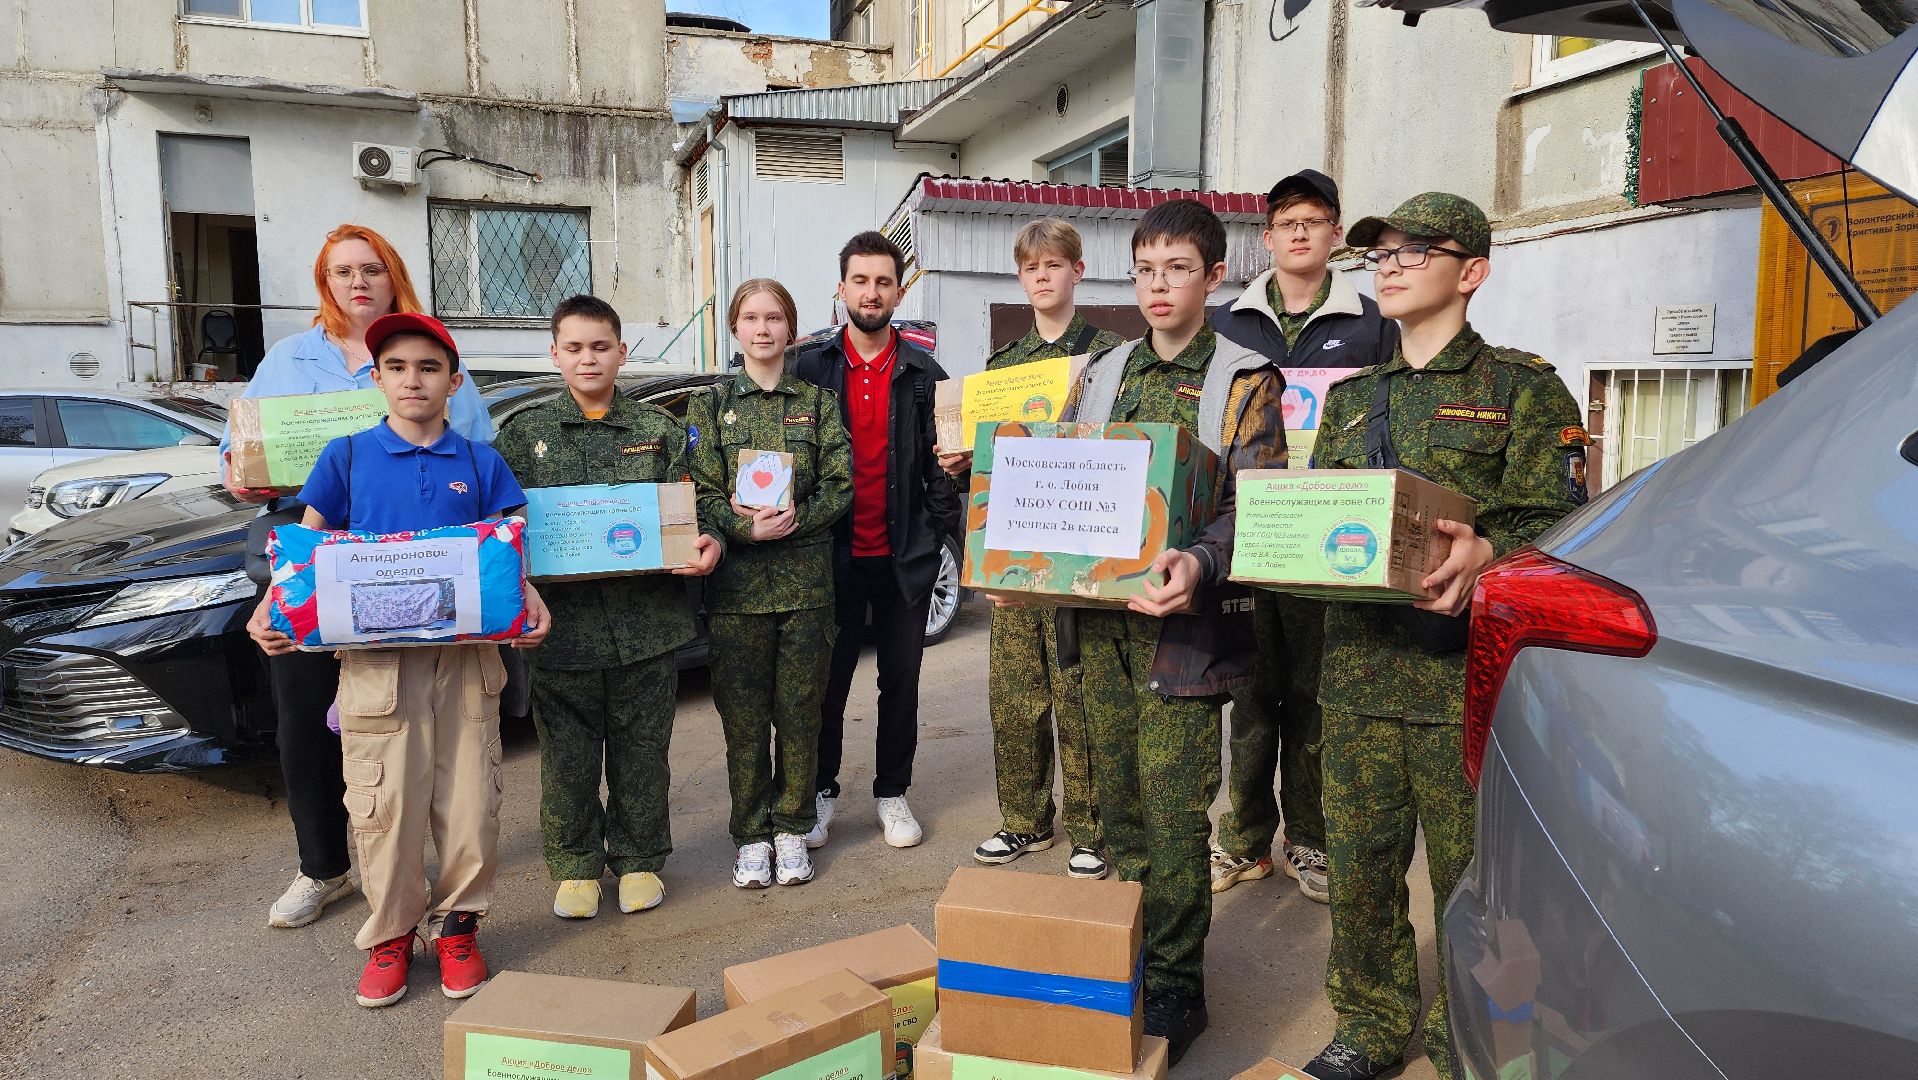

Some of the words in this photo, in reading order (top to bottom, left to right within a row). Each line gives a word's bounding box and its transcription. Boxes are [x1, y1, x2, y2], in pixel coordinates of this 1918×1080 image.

[1848, 210, 1914, 225] Волонтерский
[1439, 408, 1475, 418] ТИМОФЕЕВ
[1476, 410, 1506, 420] НИКИТА
[1004, 456, 1076, 471] Московская
[1079, 460, 1126, 472] область
[1034, 480, 1044, 490] г.
[1047, 481, 1057, 490] о.
[1060, 480, 1100, 492] Лобня
[1266, 482, 1294, 491] Акция
[1296, 481, 1336, 490] «Доброе
[1014, 497, 1054, 510] МБОУ
[1058, 499, 1092, 512] СОШ
[1096, 500, 1116, 512] №3
[1250, 498, 1330, 507] Военнослужащим
[1365, 497, 1385, 506] СВО
[1008, 520, 1057, 532] ученики
[1060, 520, 1075, 532] 2в
[1078, 522, 1119, 534] класса
[350, 550, 448, 564] Антидроновое
[376, 566, 424, 578] одеяло
[893, 1004, 914, 1016] ело»
[902, 1016, 918, 1027] СВО
[502, 1056, 527, 1067] Акция
[530, 1060, 565, 1071] «Доброе
[567, 1066, 592, 1074] дело»
